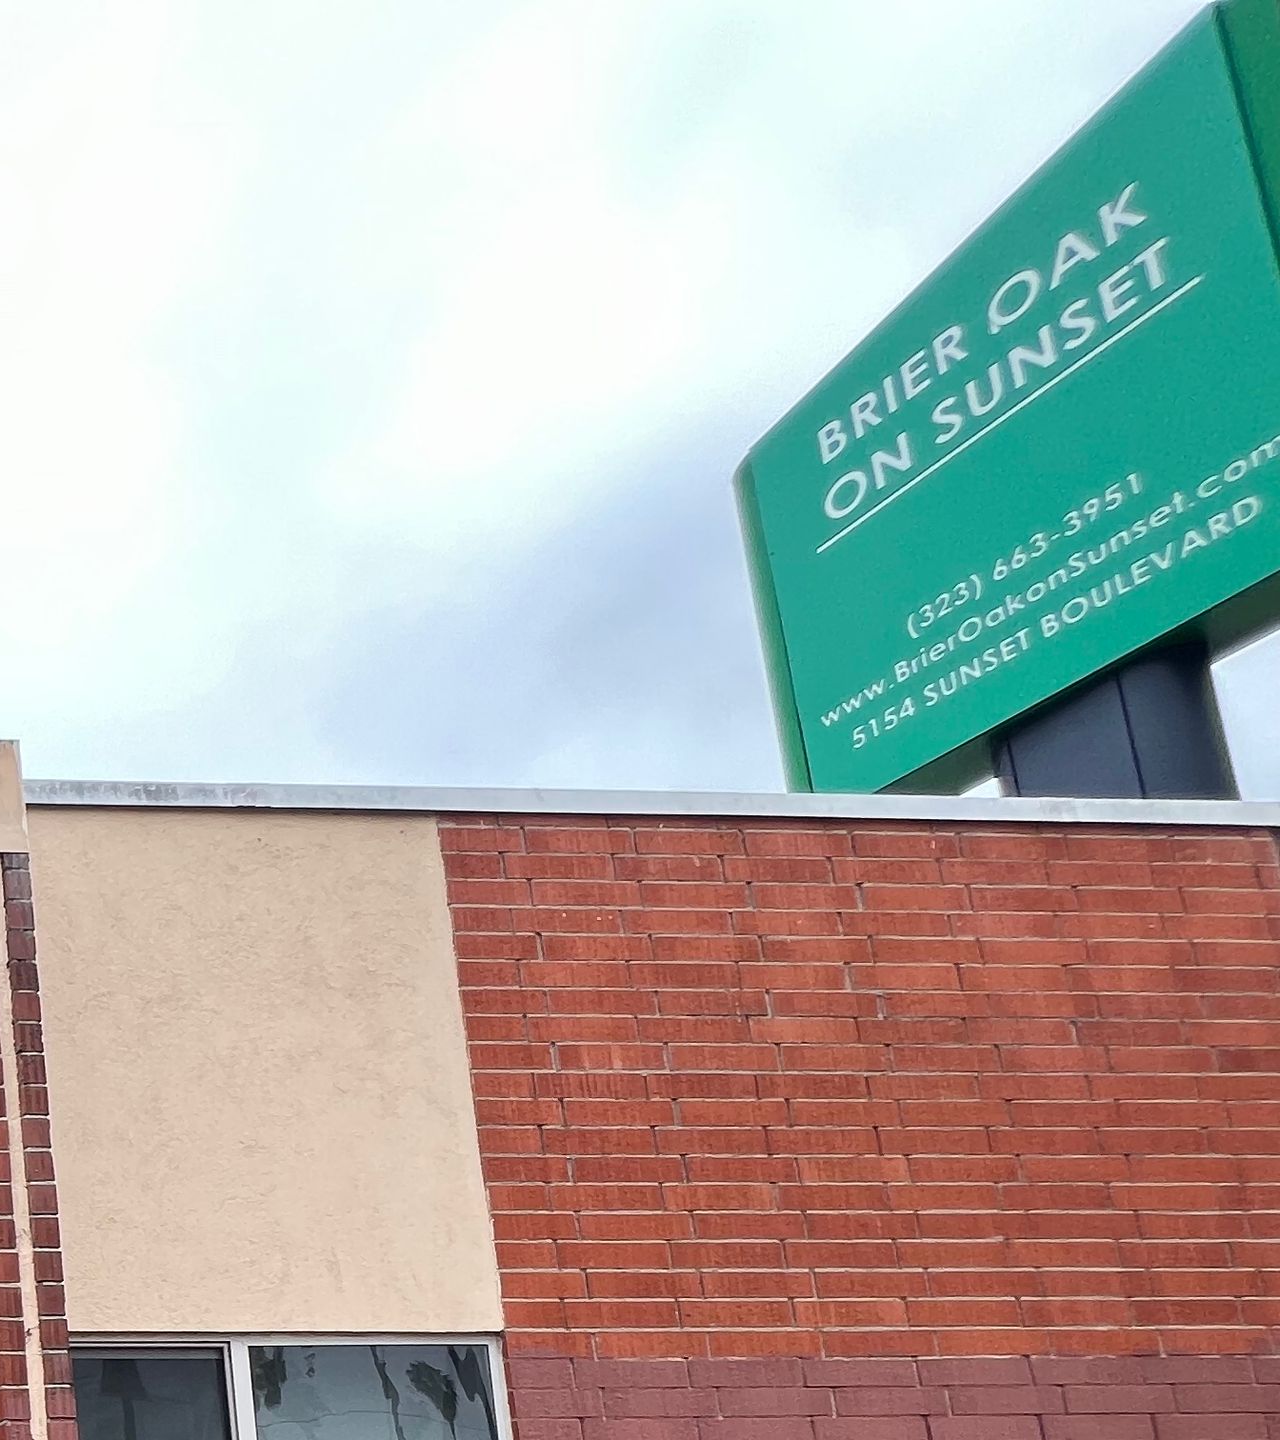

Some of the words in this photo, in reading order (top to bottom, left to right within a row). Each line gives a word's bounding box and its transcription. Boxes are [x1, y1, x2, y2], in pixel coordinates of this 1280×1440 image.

[817, 324, 968, 464] BRIER
[987, 181, 1148, 335] OAK
[824, 432, 913, 519] ON
[931, 236, 1170, 444] SUNSET
[820, 434, 1280, 727] www.BrierOakonSunset.com
[852, 696, 916, 749] 5154
[923, 627, 1031, 707] SUNSET
[1040, 495, 1262, 638] BOULEVARD
[906, 573, 983, 639] (323)
[992, 472, 1142, 581] 663-3951
